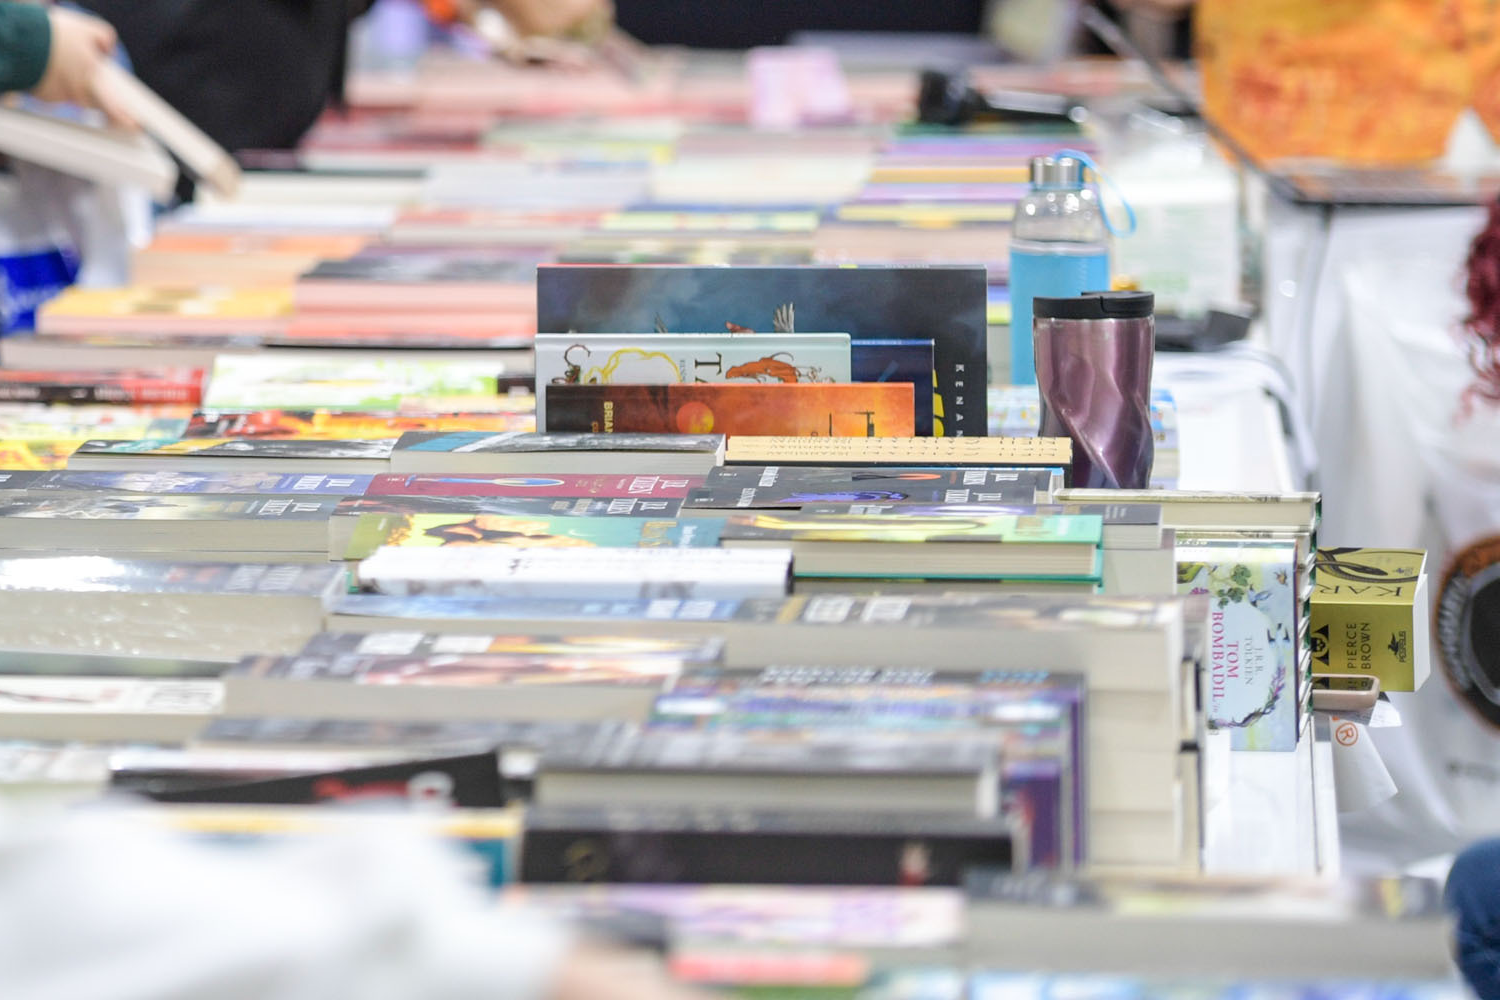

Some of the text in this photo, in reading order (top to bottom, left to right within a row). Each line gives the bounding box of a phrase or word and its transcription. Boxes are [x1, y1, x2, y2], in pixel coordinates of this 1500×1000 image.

[955, 364, 965, 437] KENAN
[1227, 640, 1239, 678] TOM
[1244, 635, 1253, 685] TOLKIEN
[1346, 623, 1357, 669] PIERCE
[1361, 623, 1372, 669] BROWN
